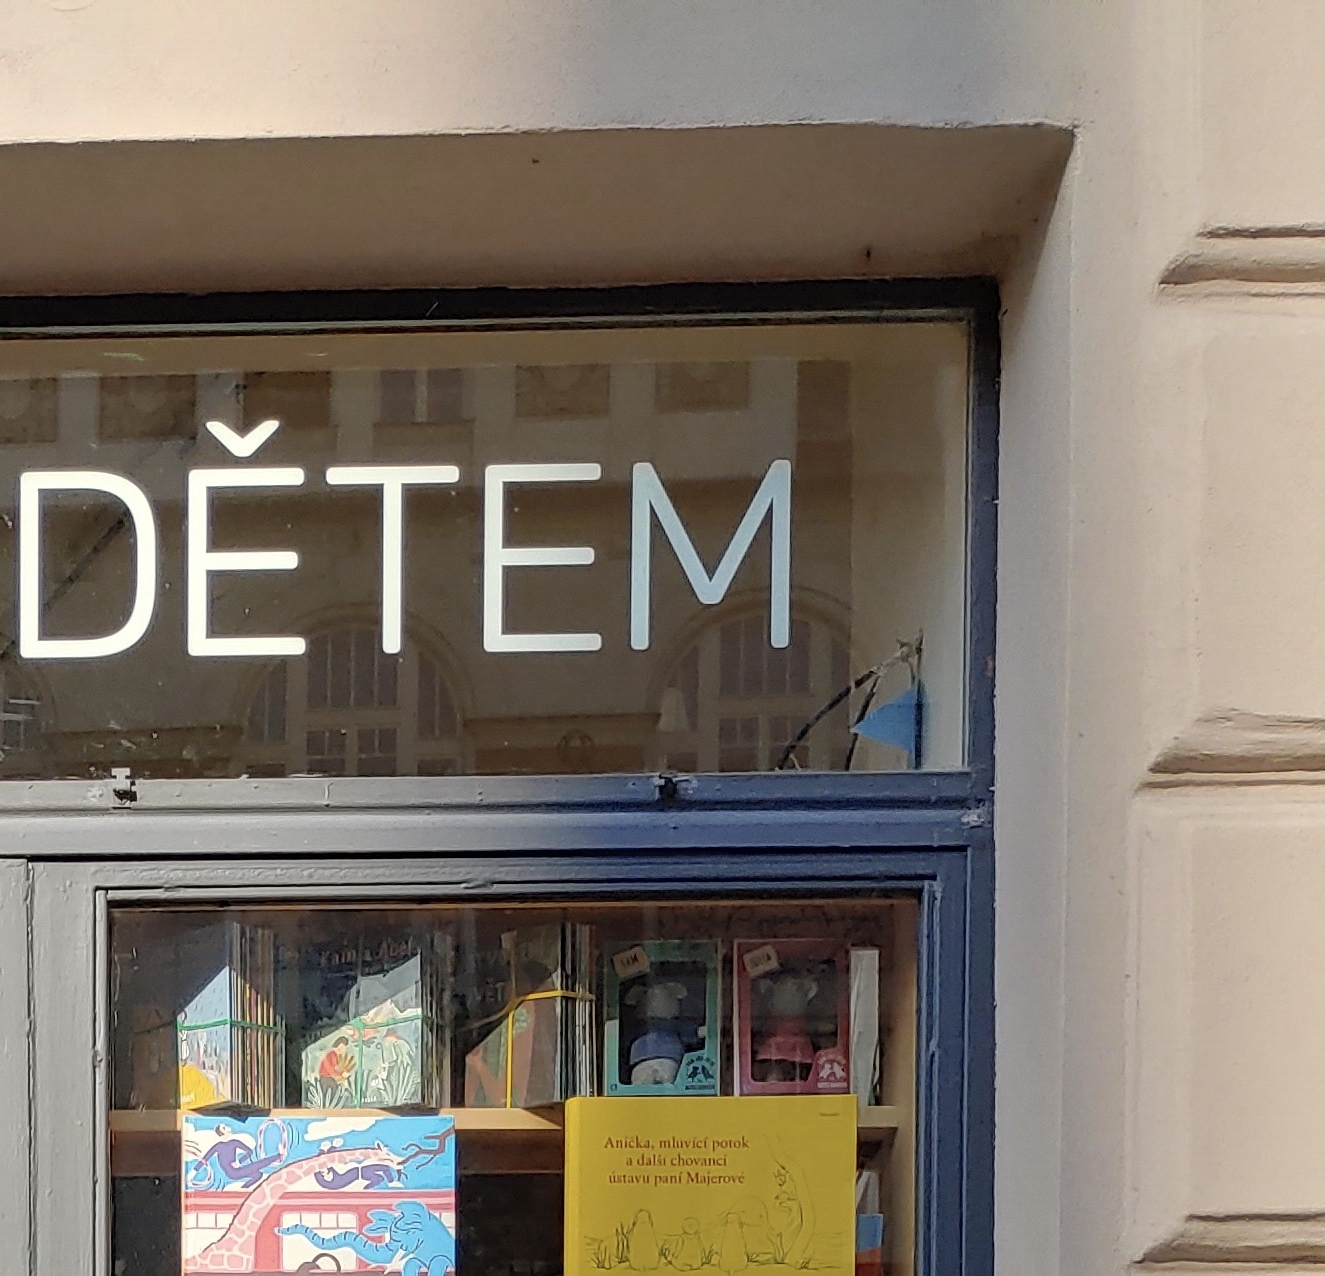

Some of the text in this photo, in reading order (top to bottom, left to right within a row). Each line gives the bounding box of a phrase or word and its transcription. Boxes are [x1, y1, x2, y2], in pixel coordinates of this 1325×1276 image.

[18, 419, 793, 660] DĚTEM
[604, 1135, 750, 1152] Anička, mluvící potok
[670, 1154, 727, 1167] chovanci
[609, 1171, 745, 1187] ústavu paní Majerové
